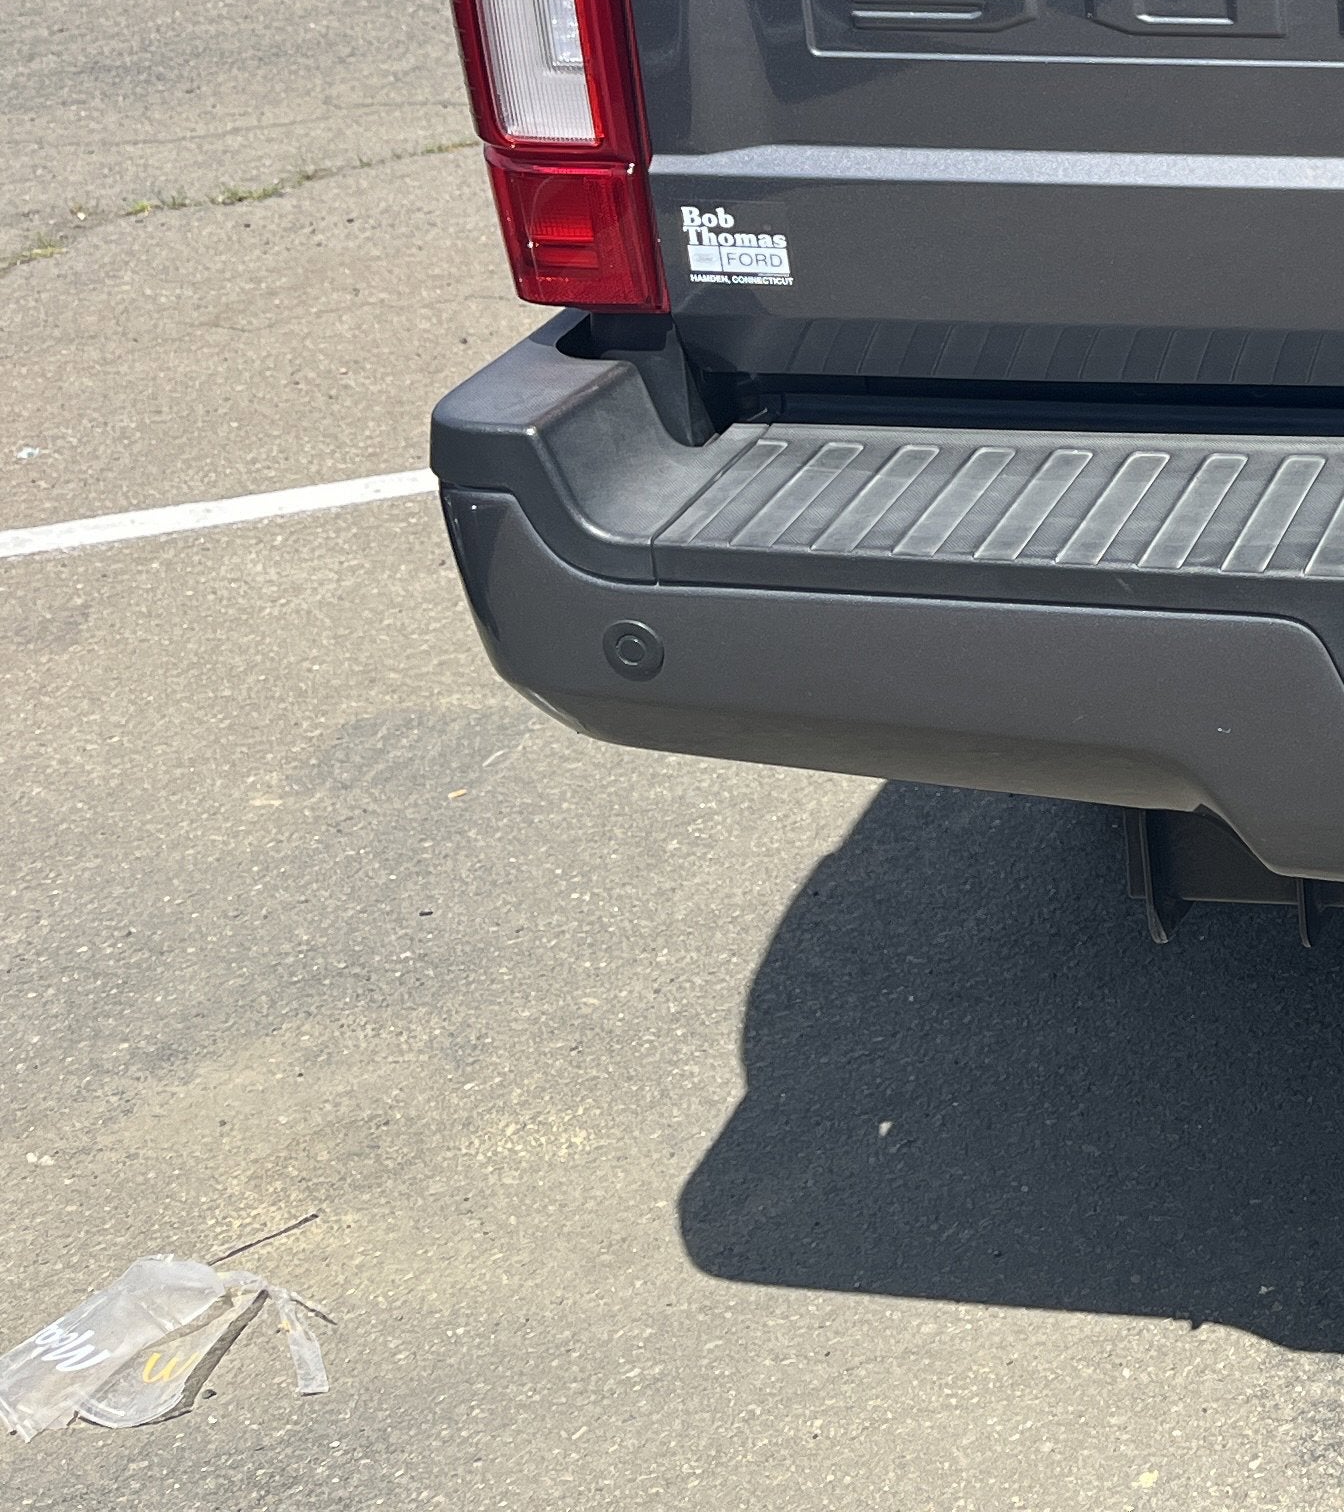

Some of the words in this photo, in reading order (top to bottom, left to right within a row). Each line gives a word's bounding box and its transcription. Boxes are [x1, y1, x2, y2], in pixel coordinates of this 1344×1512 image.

[680, 206, 735, 228] Bob
[683, 226, 787, 248] Thomas
[726, 252, 783, 268] FORD
[732, 275, 794, 285] CONNECTICUT
